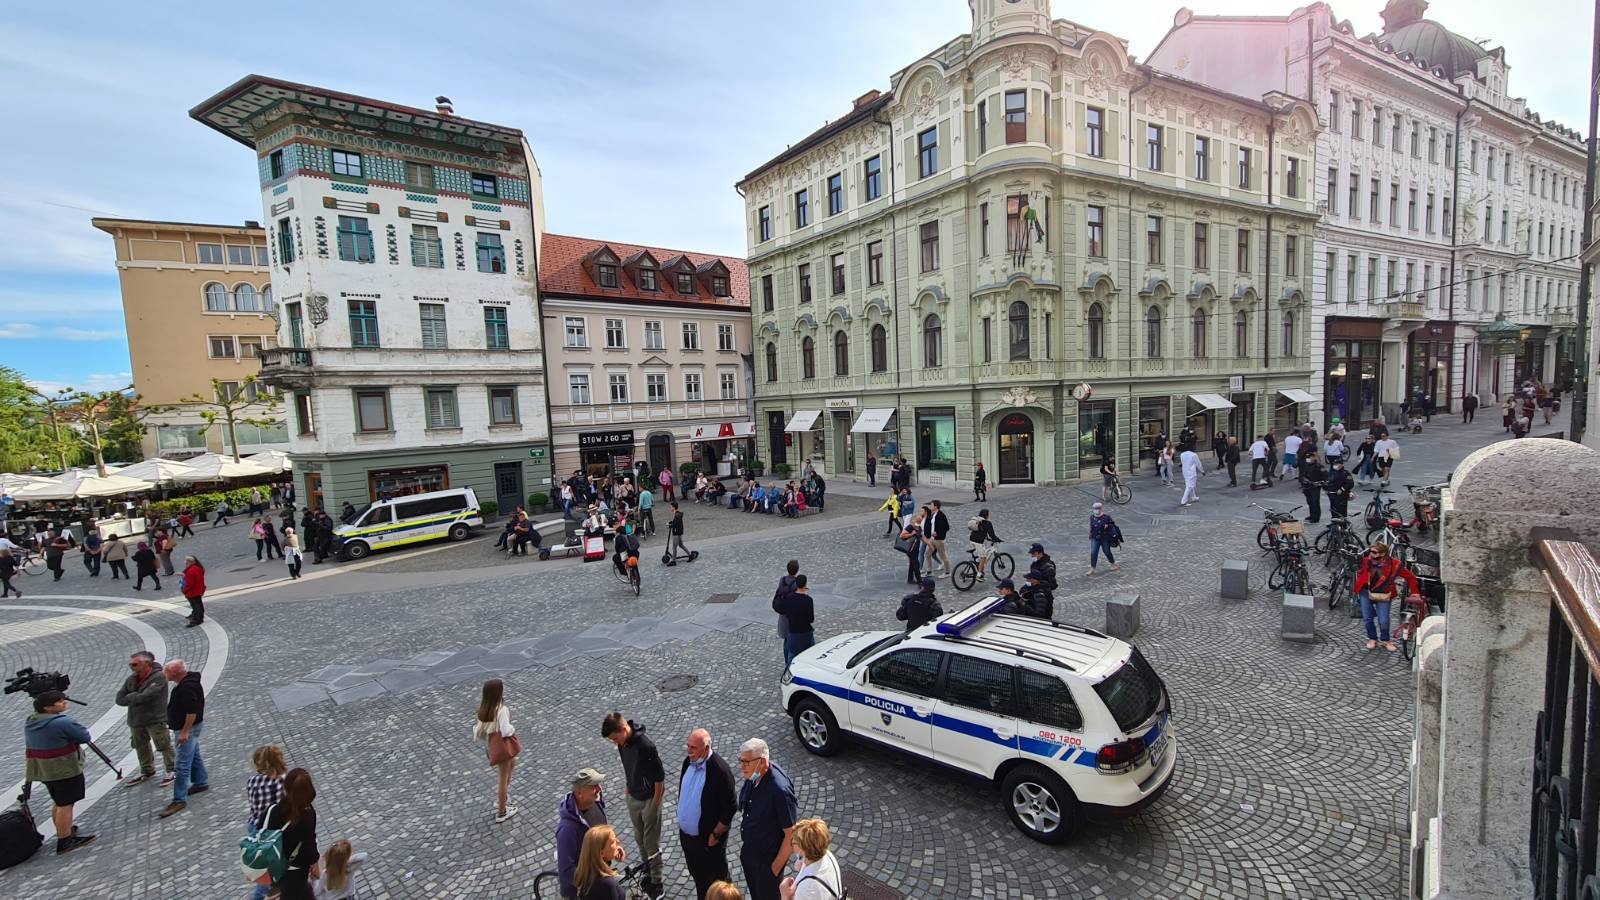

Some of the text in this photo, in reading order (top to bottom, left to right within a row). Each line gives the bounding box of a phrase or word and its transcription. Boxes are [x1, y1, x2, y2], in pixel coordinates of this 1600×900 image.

[582, 436, 602, 444] STOW
[610, 434, 620, 442] GO
[864, 695, 906, 715] POLICIJA
[1038, 730, 1082, 746] 080 1200
